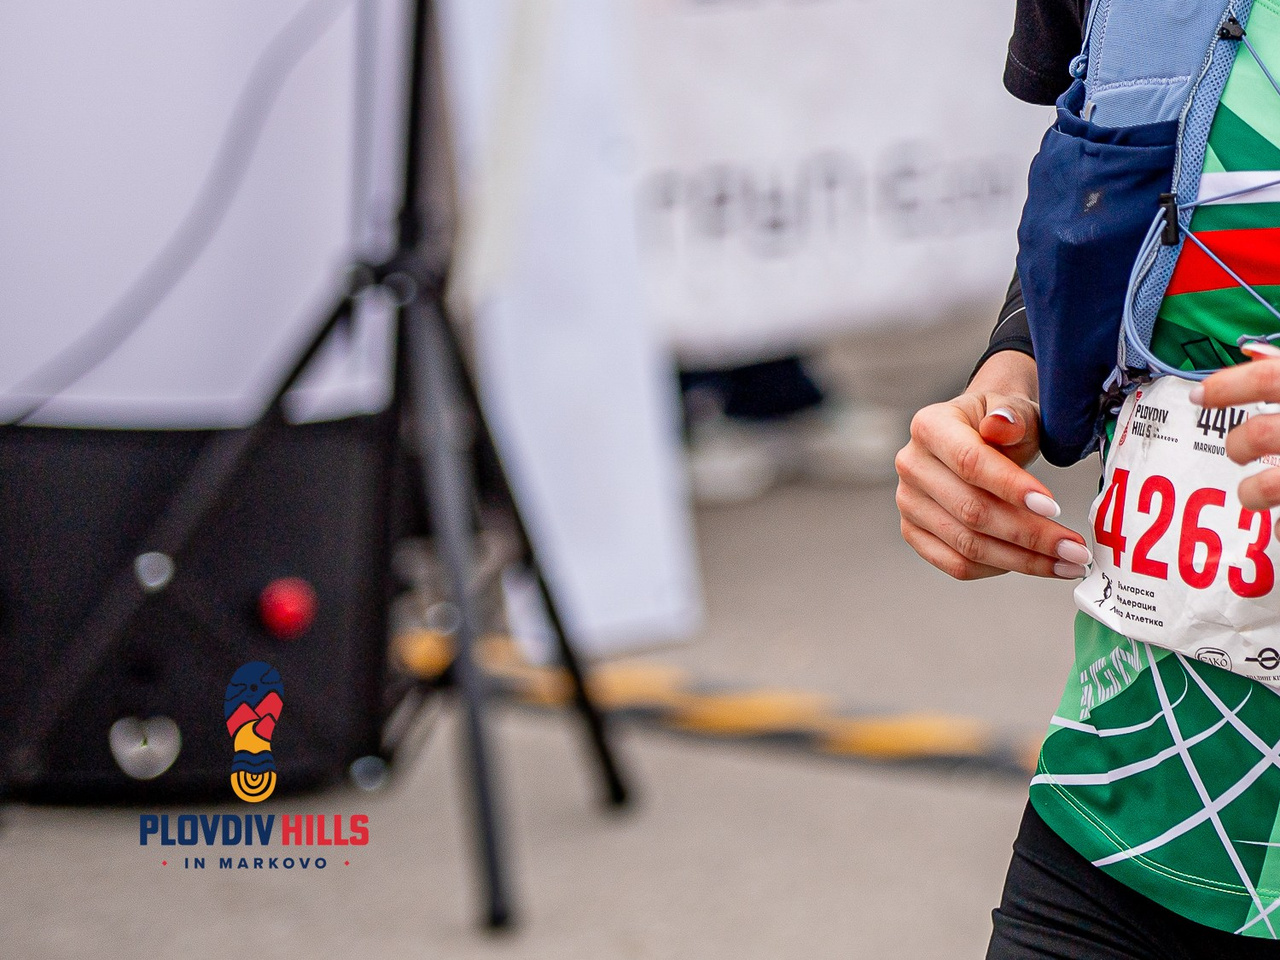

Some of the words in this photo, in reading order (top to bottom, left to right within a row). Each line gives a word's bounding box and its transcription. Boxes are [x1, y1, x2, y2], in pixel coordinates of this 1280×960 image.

[1134, 404, 1169, 424] PLOVDIV
[1192, 441, 1226, 456] MARKOVO
[1094, 468, 1275, 598] 4263
[1125, 612, 1164, 627] Атлетика
